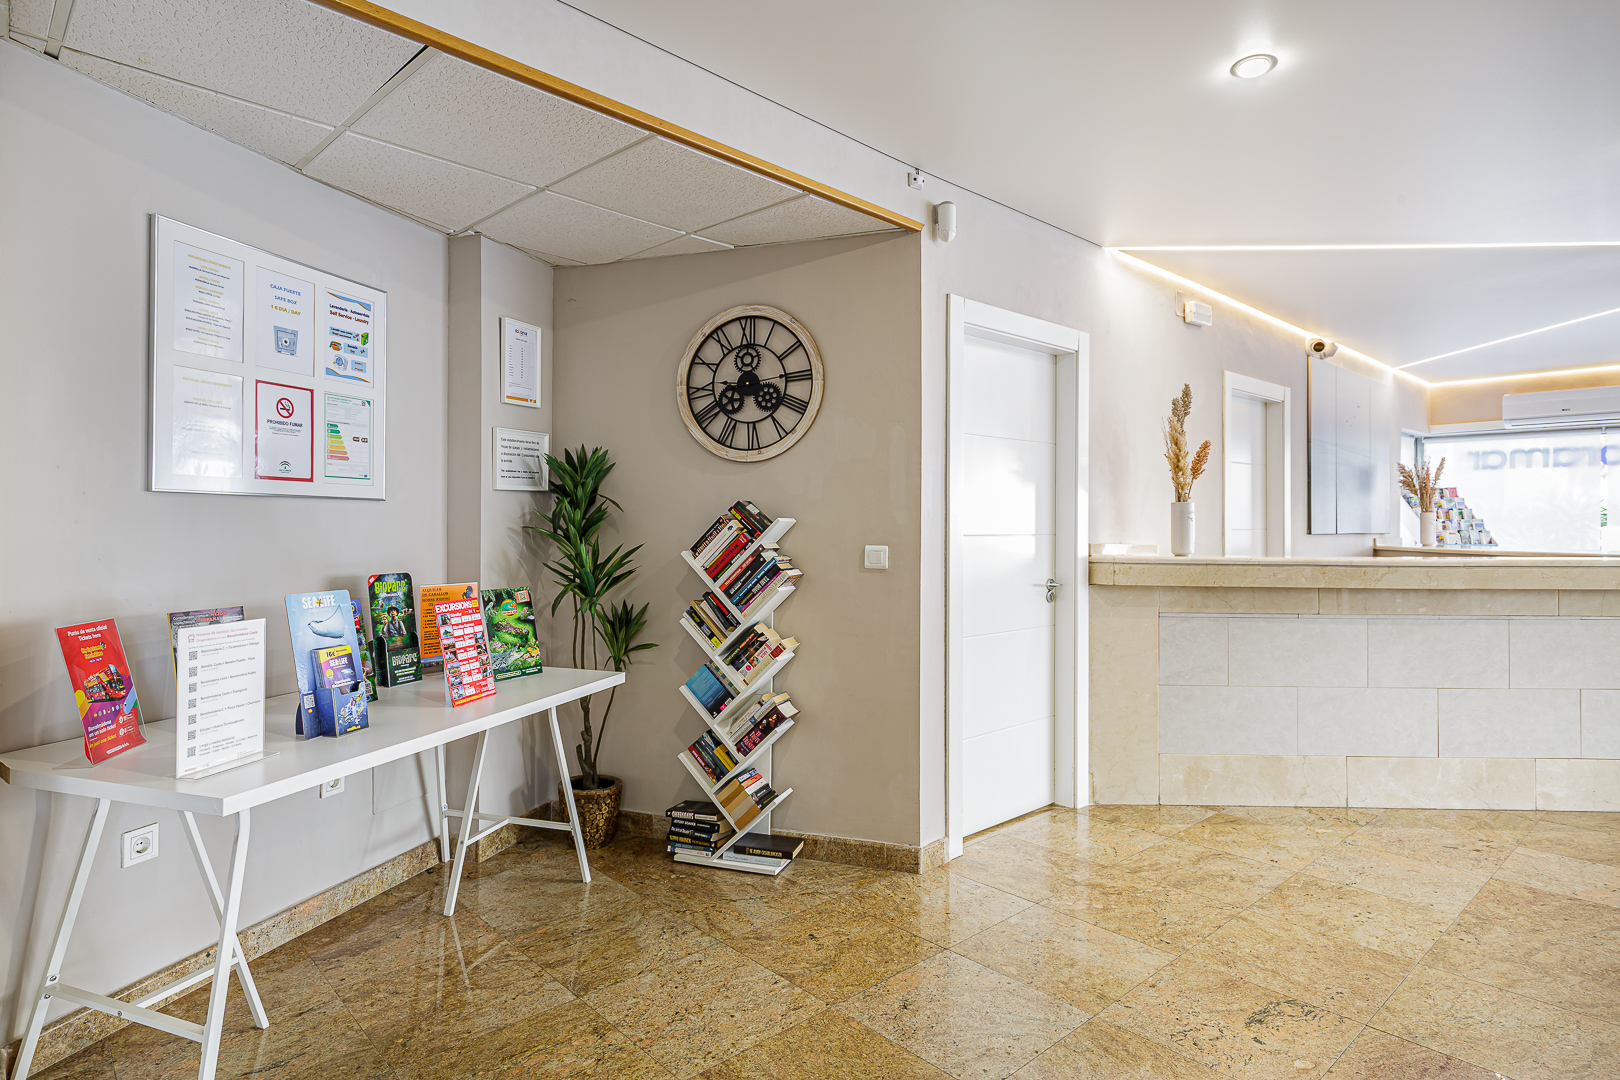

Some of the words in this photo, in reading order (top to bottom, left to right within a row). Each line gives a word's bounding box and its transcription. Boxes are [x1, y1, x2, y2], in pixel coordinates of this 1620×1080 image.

[284, 287, 301, 296] FUERTE
[355, 317, 369, 325] Laundry
[301, 596, 318, 609] SEA
[435, 601, 472, 613] EXCURSIONS
[329, 659, 338, 667] SEA
